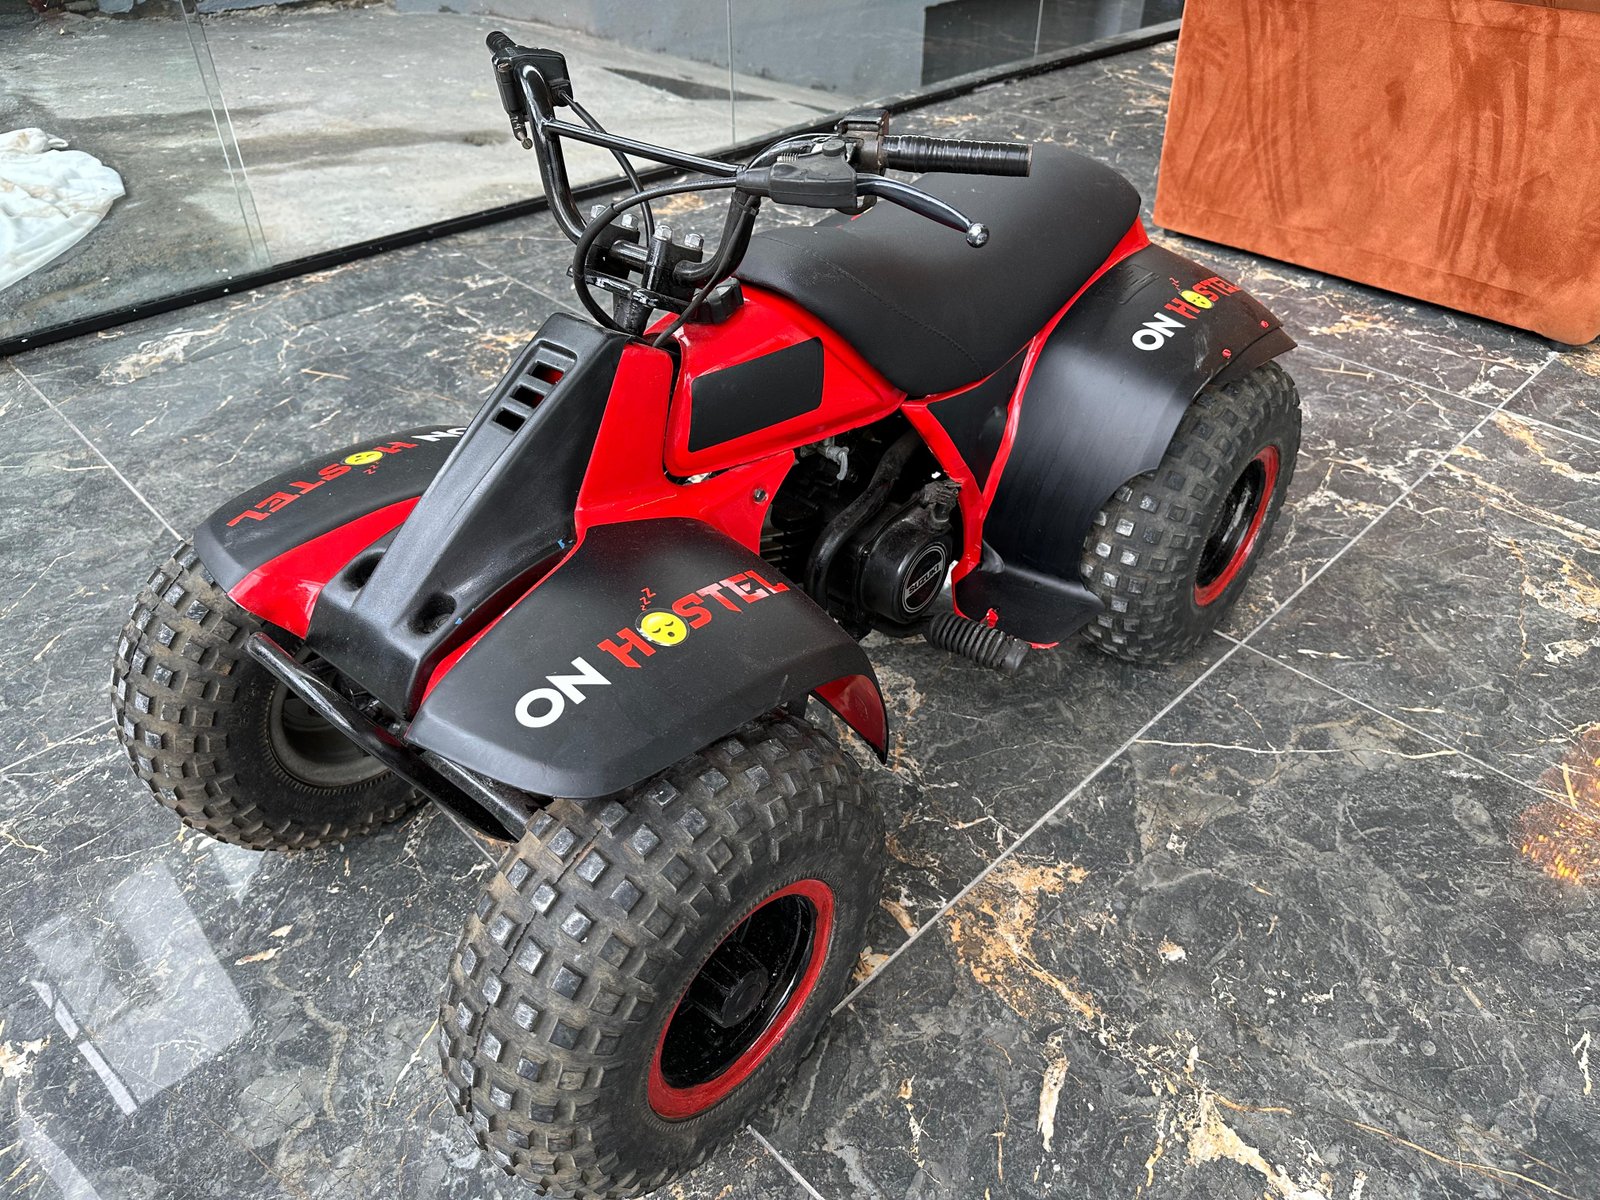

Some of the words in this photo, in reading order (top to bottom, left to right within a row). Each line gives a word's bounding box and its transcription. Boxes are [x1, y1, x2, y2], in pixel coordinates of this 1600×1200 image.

[1131, 311, 1186, 351] ON
[1164, 276, 1242, 319] HOSTEL
[226, 441, 418, 527] HOSTEL
[908, 564, 940, 595] SUZUKI
[514, 656, 612, 728] ON
[596, 569, 791, 668] HOSTEL
